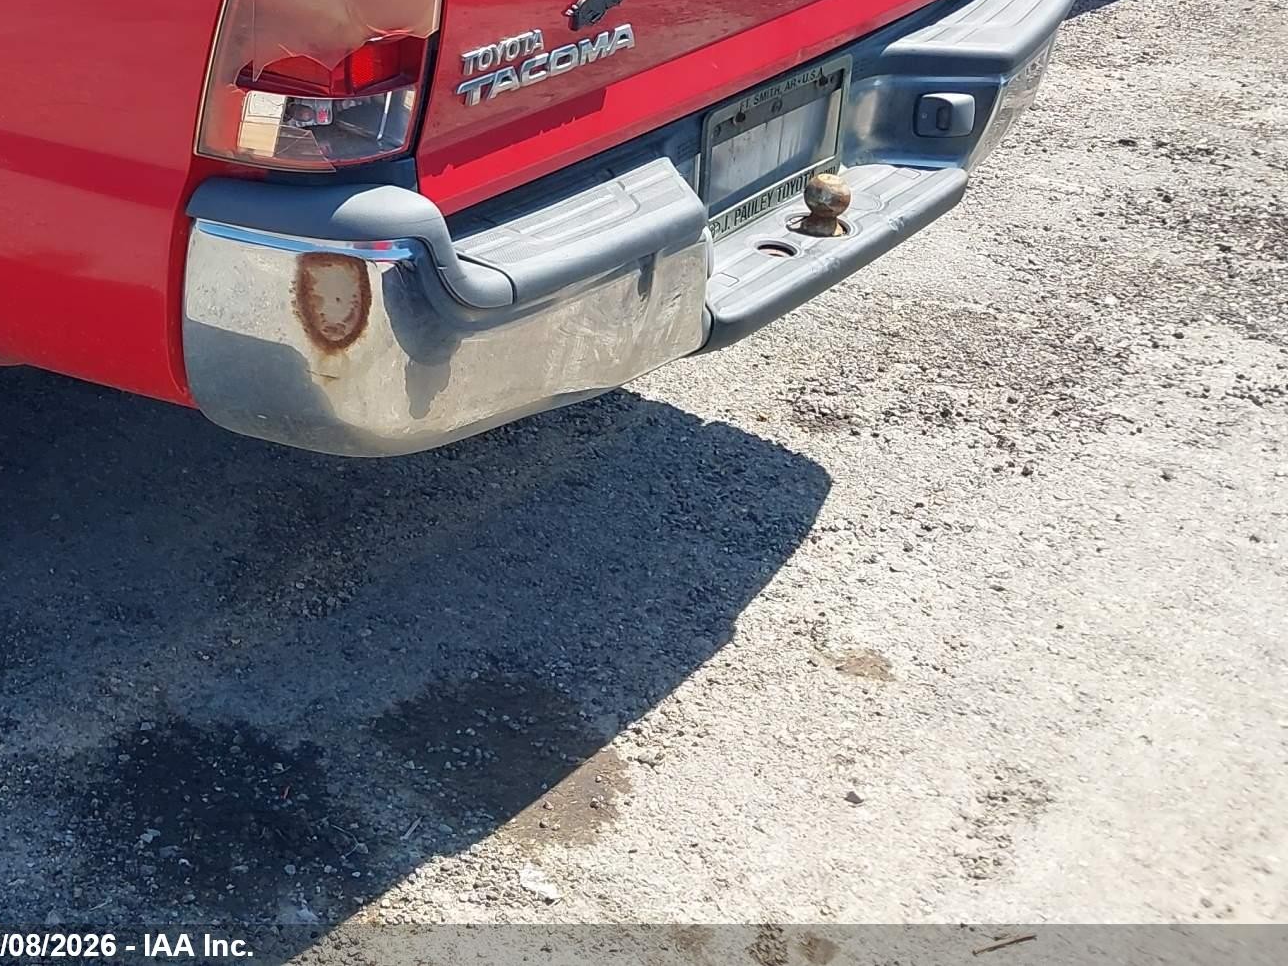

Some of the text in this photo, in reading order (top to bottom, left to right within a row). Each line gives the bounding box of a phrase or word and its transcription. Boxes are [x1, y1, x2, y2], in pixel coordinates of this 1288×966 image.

[455, 22, 636, 106] TACOMA
[461, 28, 545, 76] TOYOTA
[734, 191, 775, 227] PAULEY
[775, 169, 815, 203] TOYOTA
